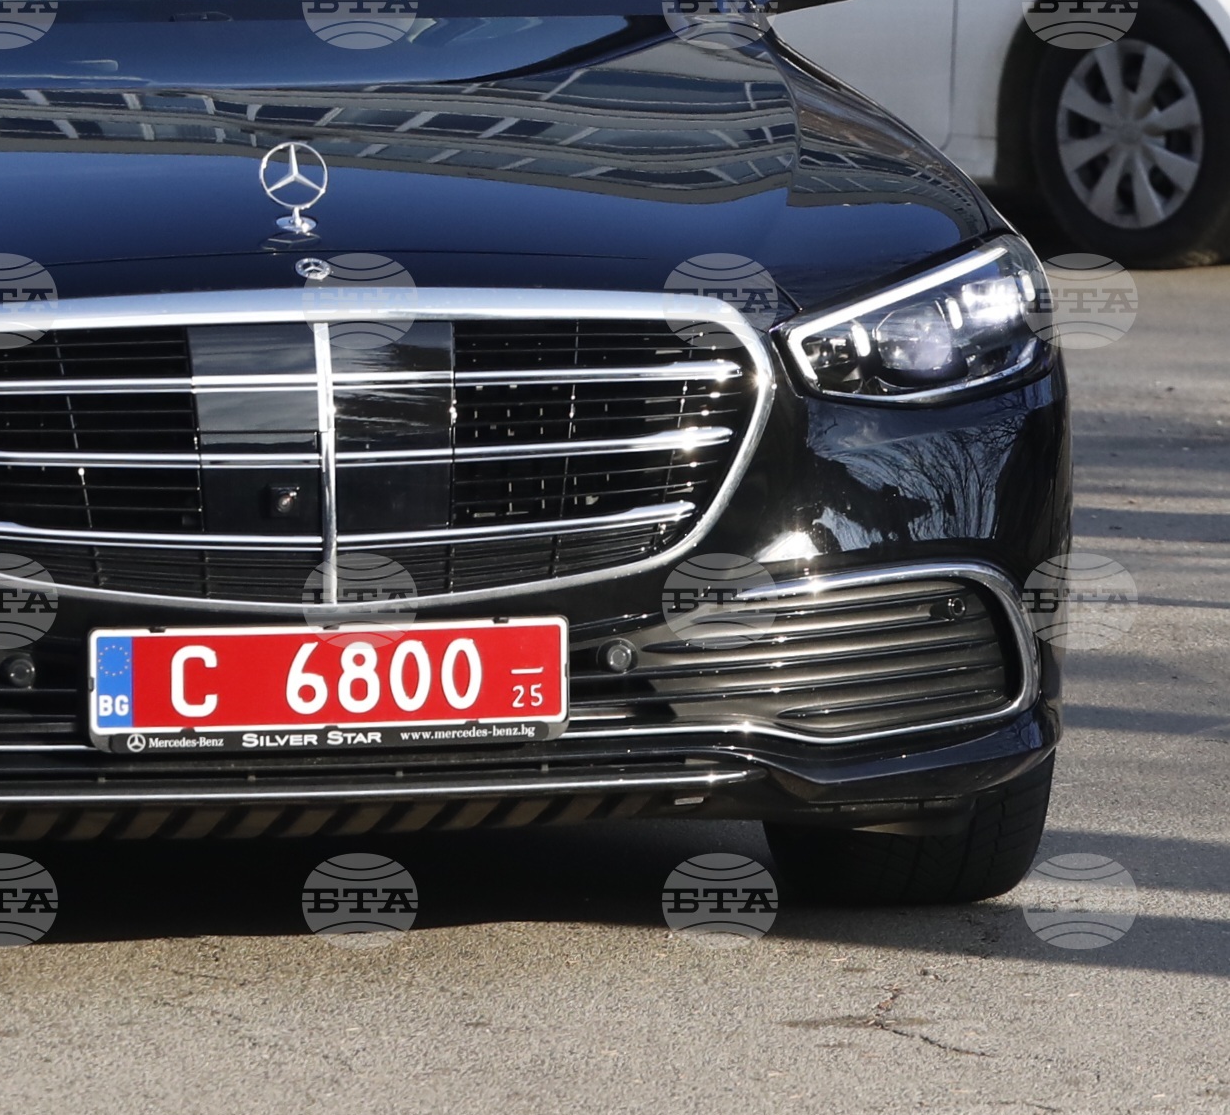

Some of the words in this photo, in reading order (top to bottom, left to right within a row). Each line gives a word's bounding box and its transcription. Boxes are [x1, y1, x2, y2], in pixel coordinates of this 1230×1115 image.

[170, 644, 218, 718] C
[285, 637, 483, 715] 6800
[98, 694, 130, 717] BG
[511, 683, 544, 709] 25
[148, 736, 224, 748] Mercedes-Benz
[400, 723, 536, 742] www.mercedes-benz.bg
